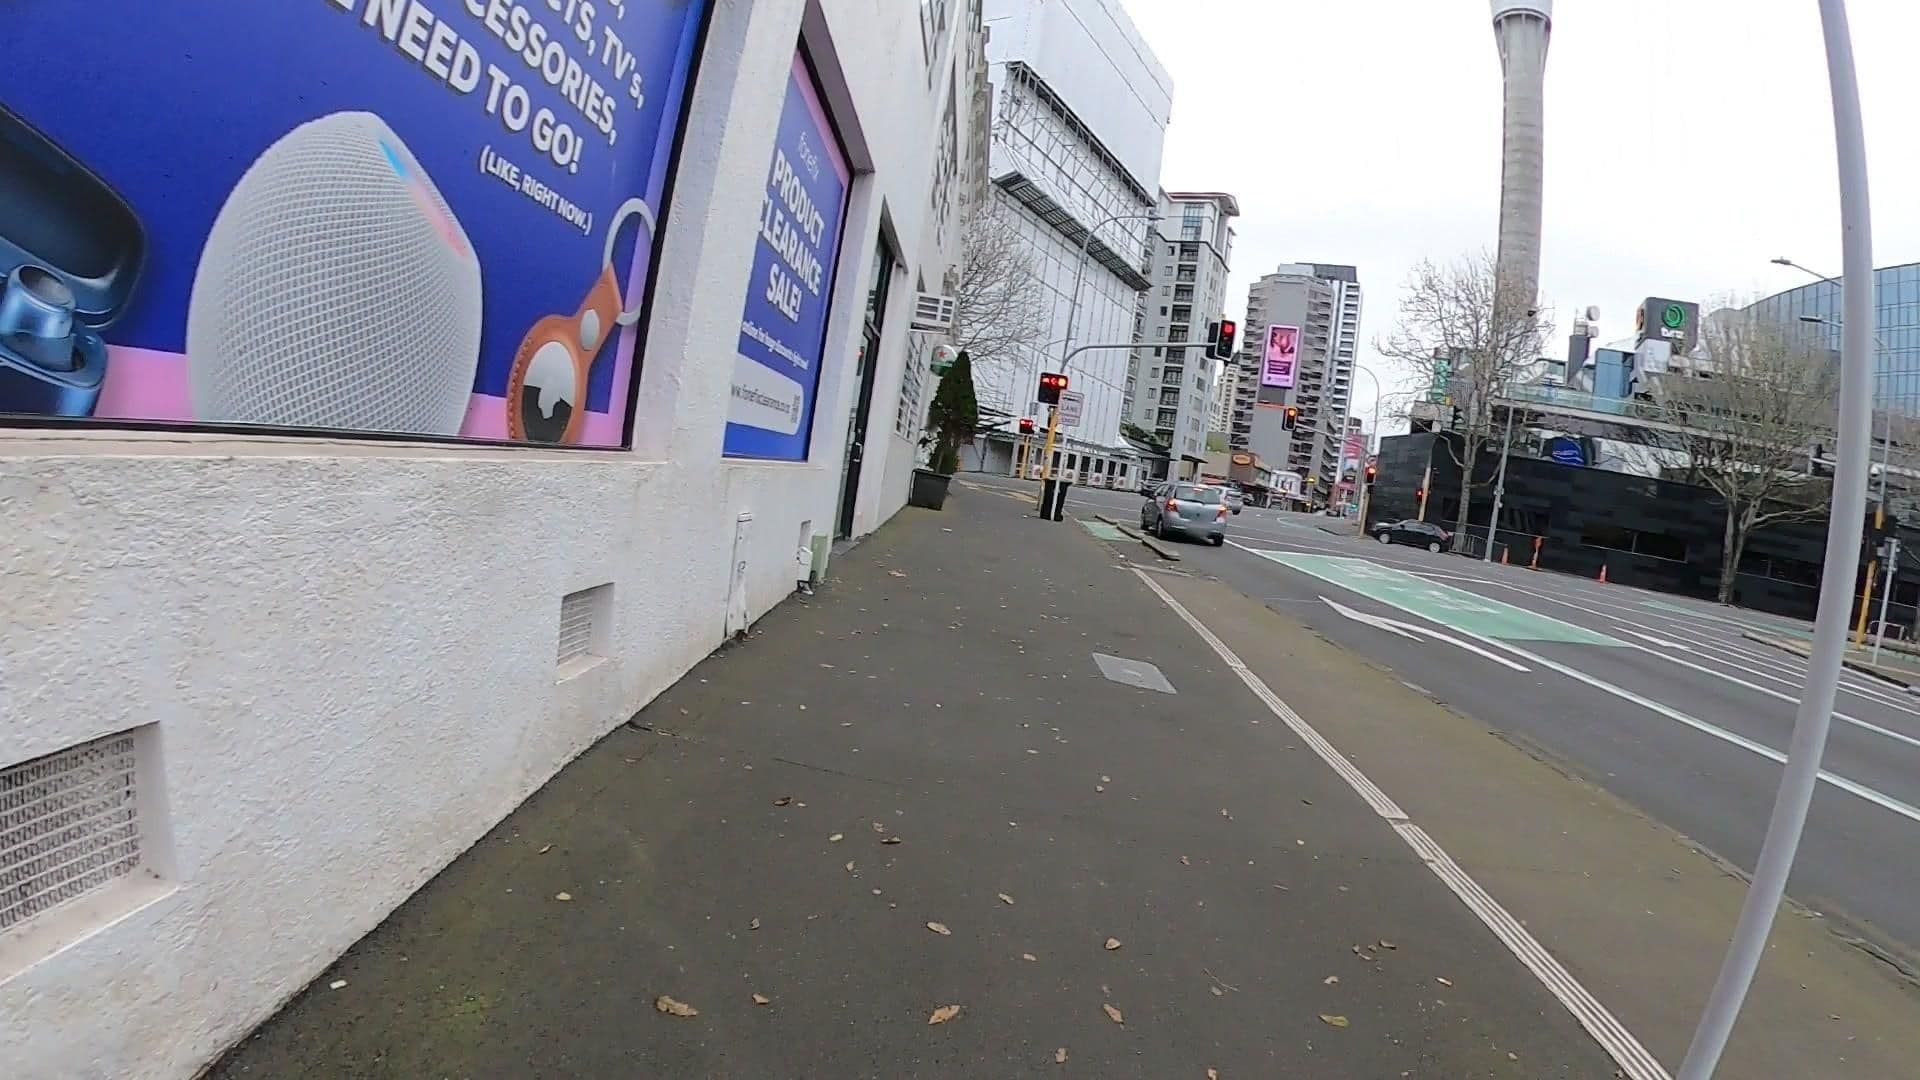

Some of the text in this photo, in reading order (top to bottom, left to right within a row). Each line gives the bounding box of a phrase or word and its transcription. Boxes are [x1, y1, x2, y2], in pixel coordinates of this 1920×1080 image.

[362, 0, 584, 174] NEED TO GO!
[480, 145, 593, 236] (LIKE, RIGHT NOW.)
[771, 148, 825, 250] PRODUCT
[766, 263, 803, 323] SALE!
